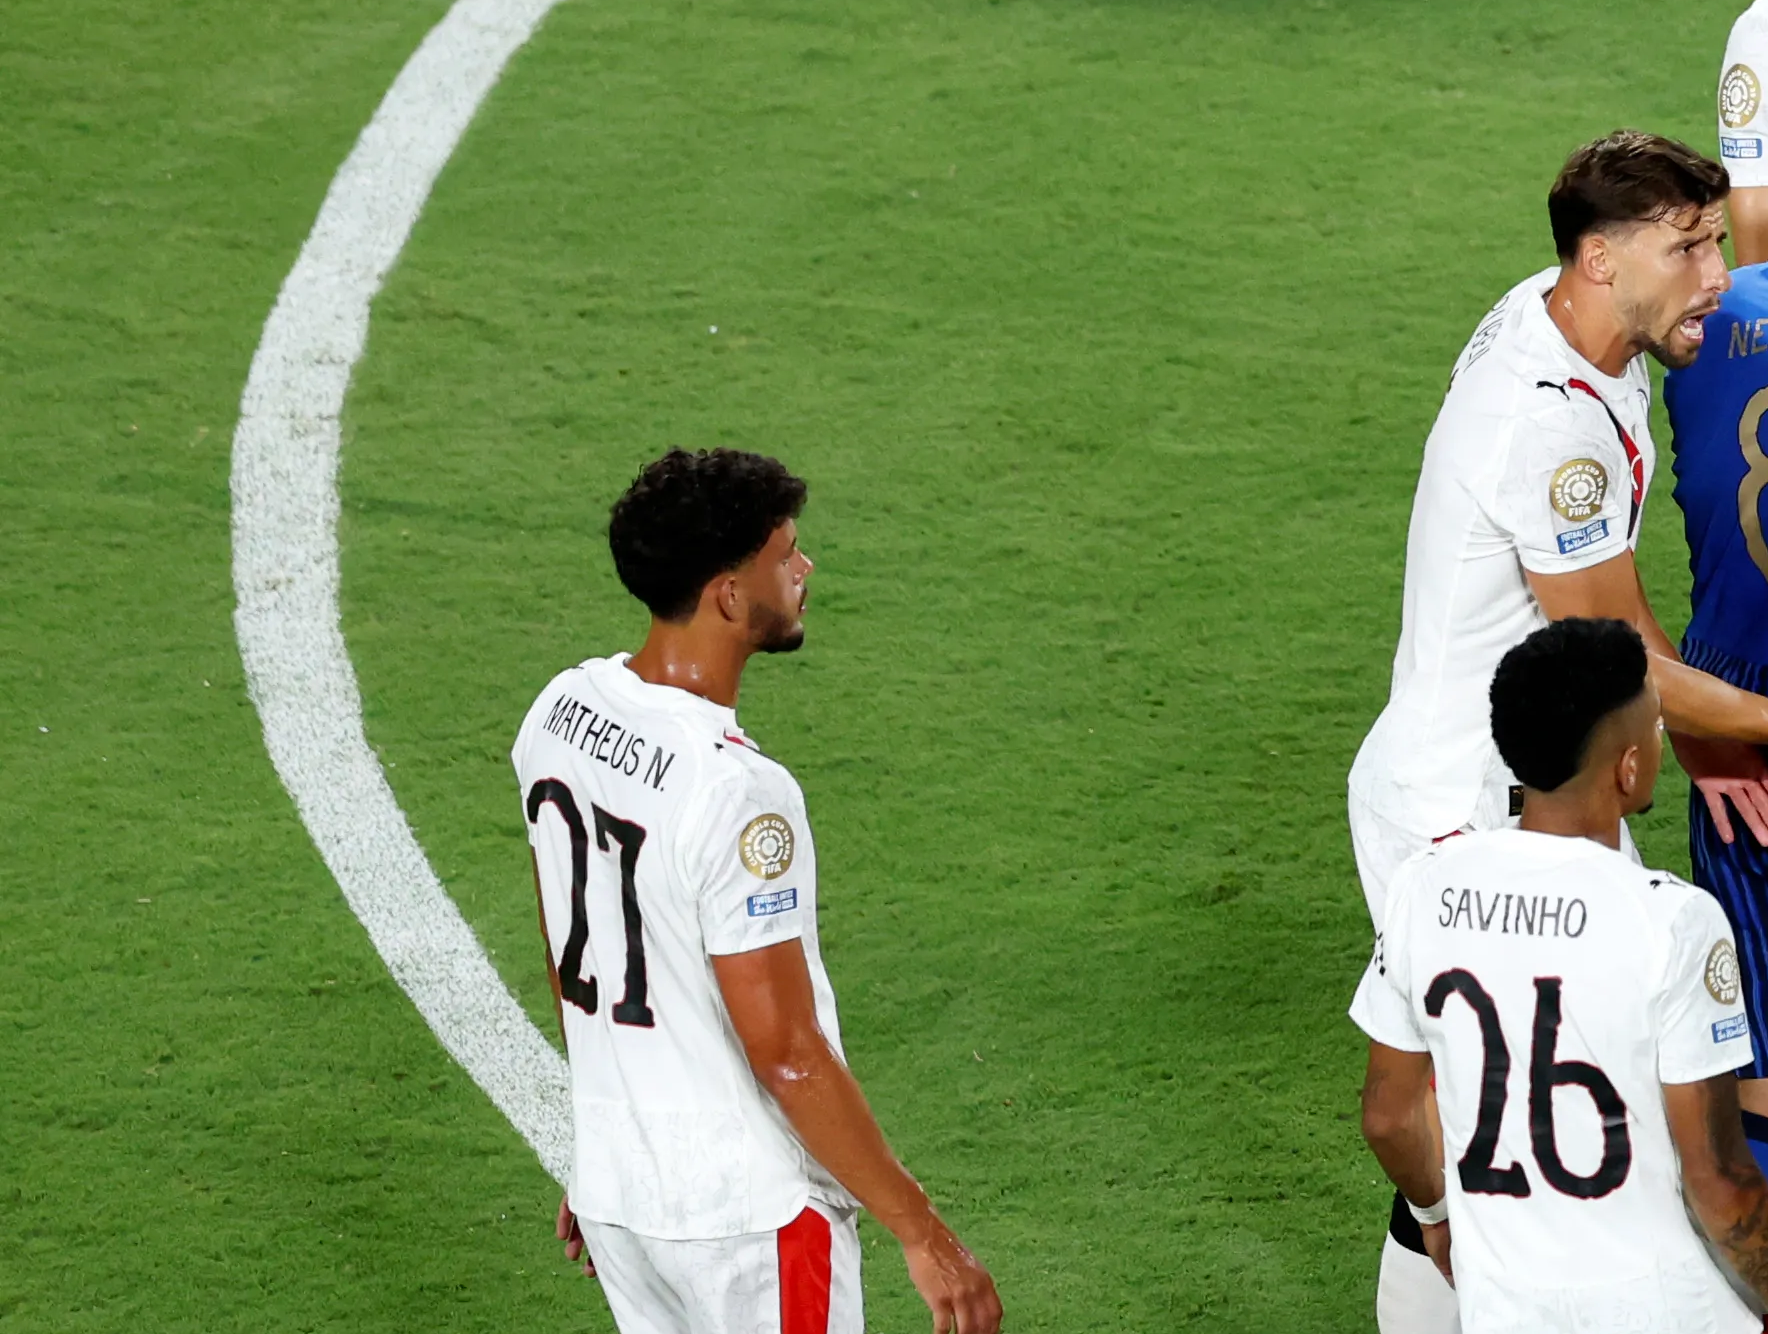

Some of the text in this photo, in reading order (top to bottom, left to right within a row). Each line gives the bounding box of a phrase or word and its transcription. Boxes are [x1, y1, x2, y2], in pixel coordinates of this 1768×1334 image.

[1557, 465, 1582, 485] WORLD
[1584, 464, 1600, 476] CUP
[1568, 506, 1591, 517] FIFA
[543, 693, 677, 792] MATHEUS N.
[745, 819, 770, 843] WORLD
[761, 862, 782, 876] FIFA
[527, 777, 655, 1029] 27
[1438, 886, 1588, 938] SAVINHO
[1423, 967, 1633, 1200] 26
